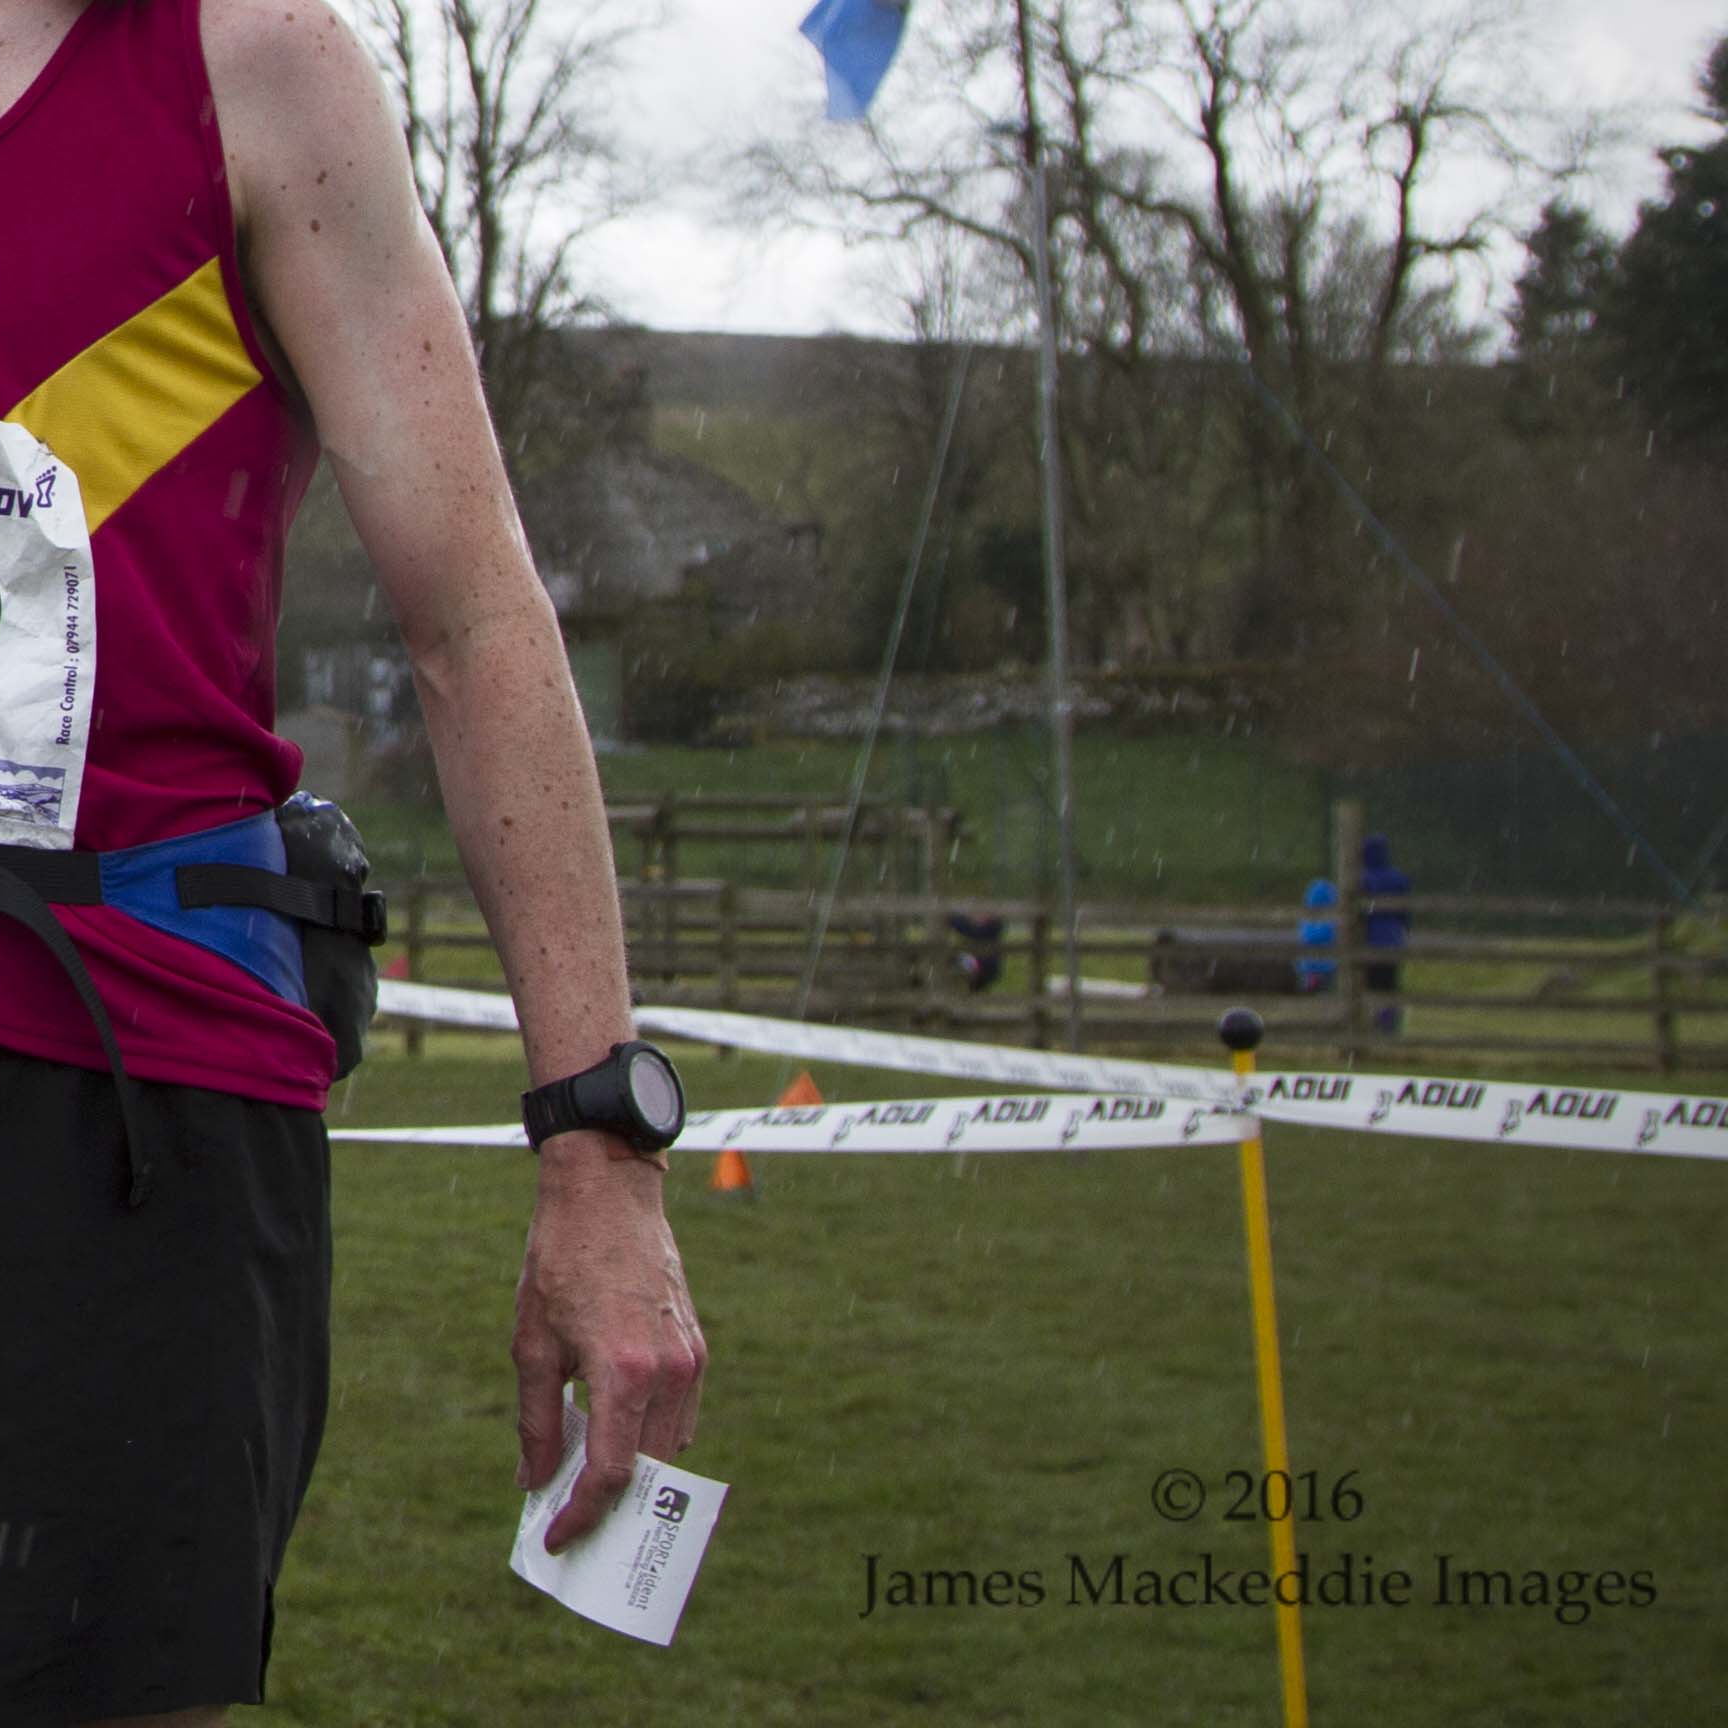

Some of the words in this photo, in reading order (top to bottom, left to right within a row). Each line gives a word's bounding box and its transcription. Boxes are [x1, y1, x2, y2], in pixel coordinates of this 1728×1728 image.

[64, 565, 80, 610] 729071
[66, 615, 81, 654] 07944
[59, 666, 78, 712] Control
[55, 716, 72, 746] Race
